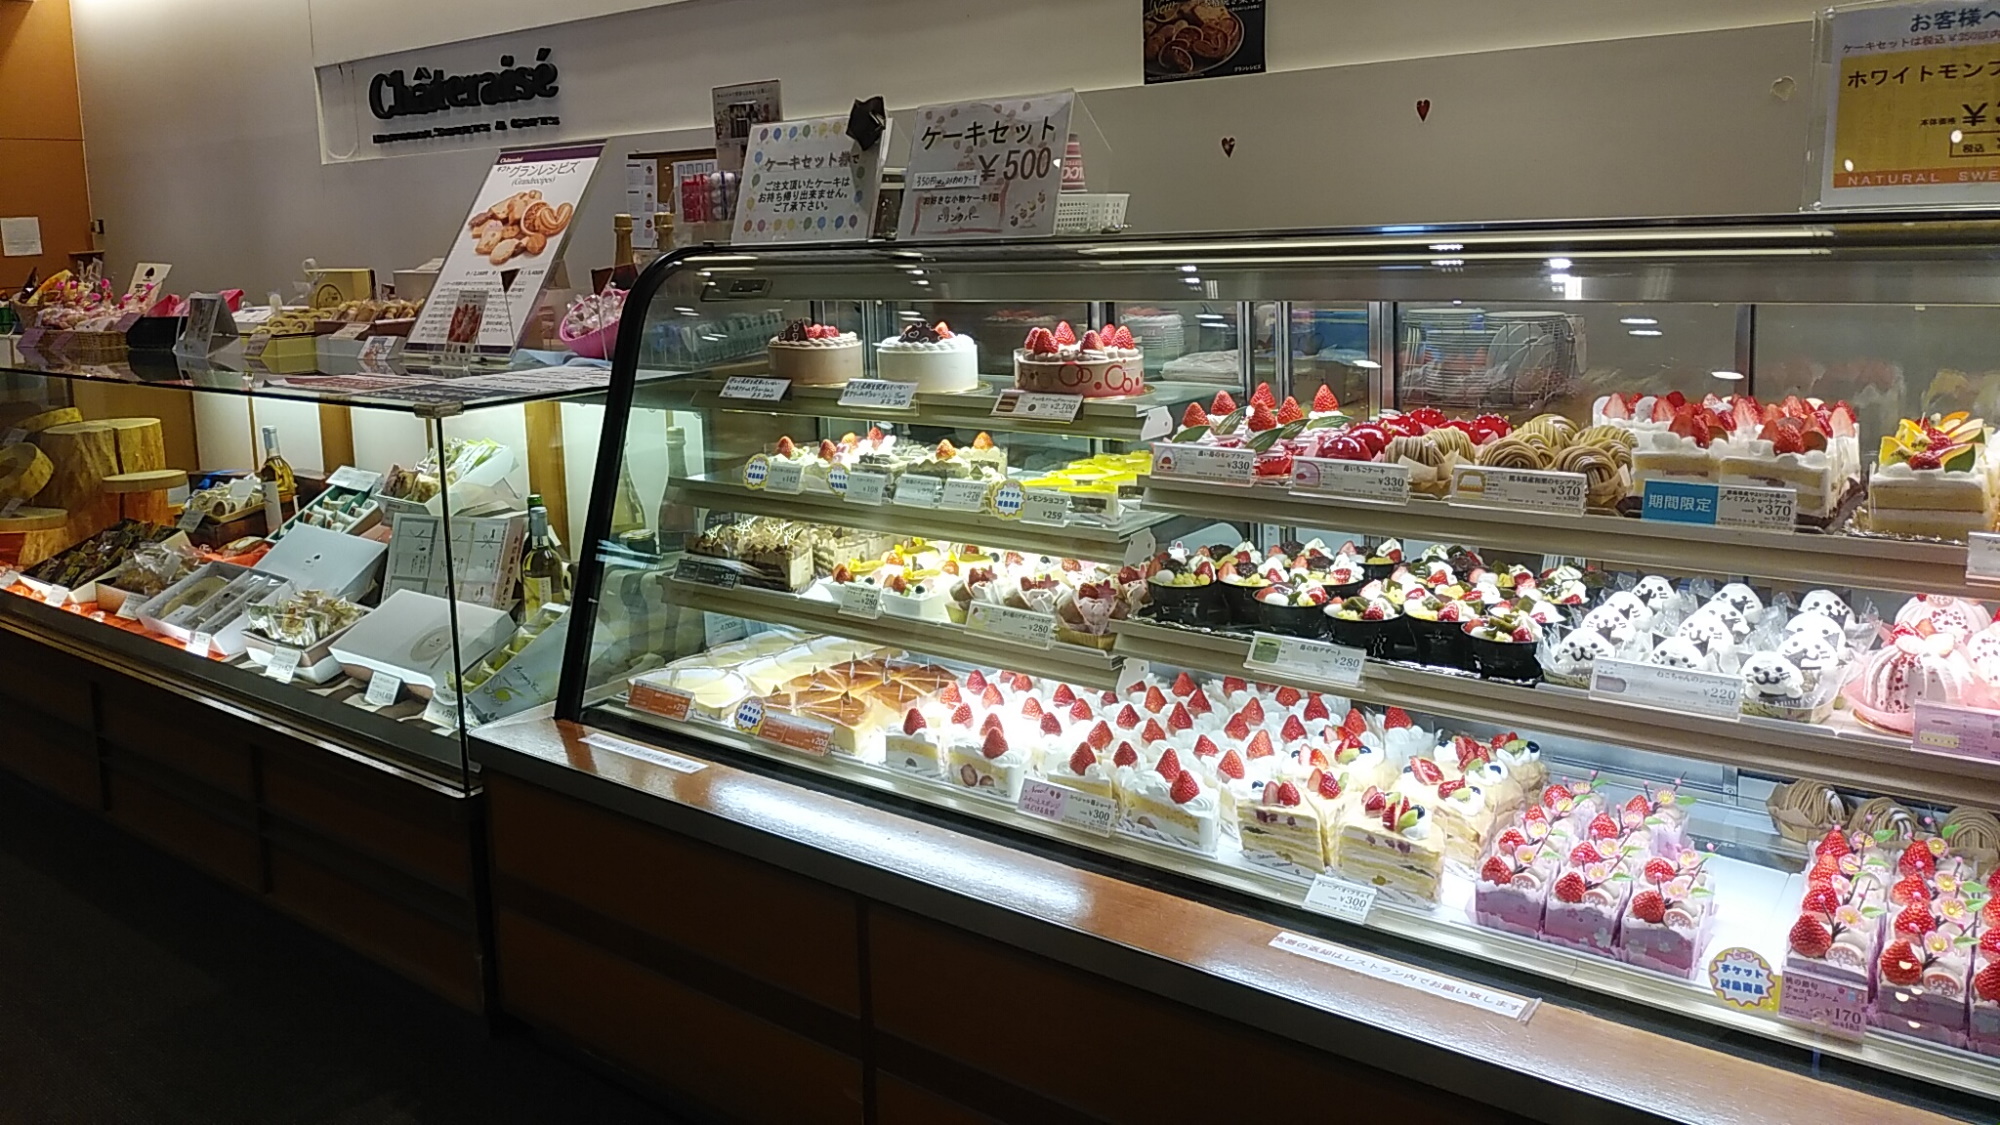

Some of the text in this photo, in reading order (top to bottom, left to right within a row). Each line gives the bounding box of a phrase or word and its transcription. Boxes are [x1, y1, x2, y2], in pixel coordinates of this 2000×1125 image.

[1910, 8, 2000, 32] お客様へ
[370, 48, 559, 119] Châteraisé
[921, 116, 1056, 151] ケーキセット
[509, 161, 580, 178] グランレシピズ
[978, 147, 1053, 182] ¥500
[765, 177, 850, 192] ご注文頂いたケーキは
[1848, 172, 1941, 187] NATURAL
[758, 189, 848, 204] お持ち帰り出来ません。
[773, 201, 829, 213] ご了承下さい。
[937, 212, 980, 223] ドリンクバー
[1227, 460, 1250, 471] ¥330
[1378, 476, 1404, 488] ¥330
[999, 490, 1021, 498] チケット
[1550, 484, 1581, 496] ¥370
[1027, 494, 1066, 505] レモンショコラ
[1648, 494, 1712, 513] 期間限定
[1043, 510, 1063, 520] ¥259
[1757, 504, 1792, 517] ¥370
[1029, 623, 1049, 634] ¥280
[1335, 656, 1360, 668] ¥280
[1703, 687, 1737, 700] ¥220
[1088, 808, 1110, 821] ¥300
[1340, 895, 1367, 908] ¥300
[1721, 963, 1763, 979] チケット
[1720, 978, 1764, 995] 対象商品
[1826, 1007, 1862, 1025] ¥170
